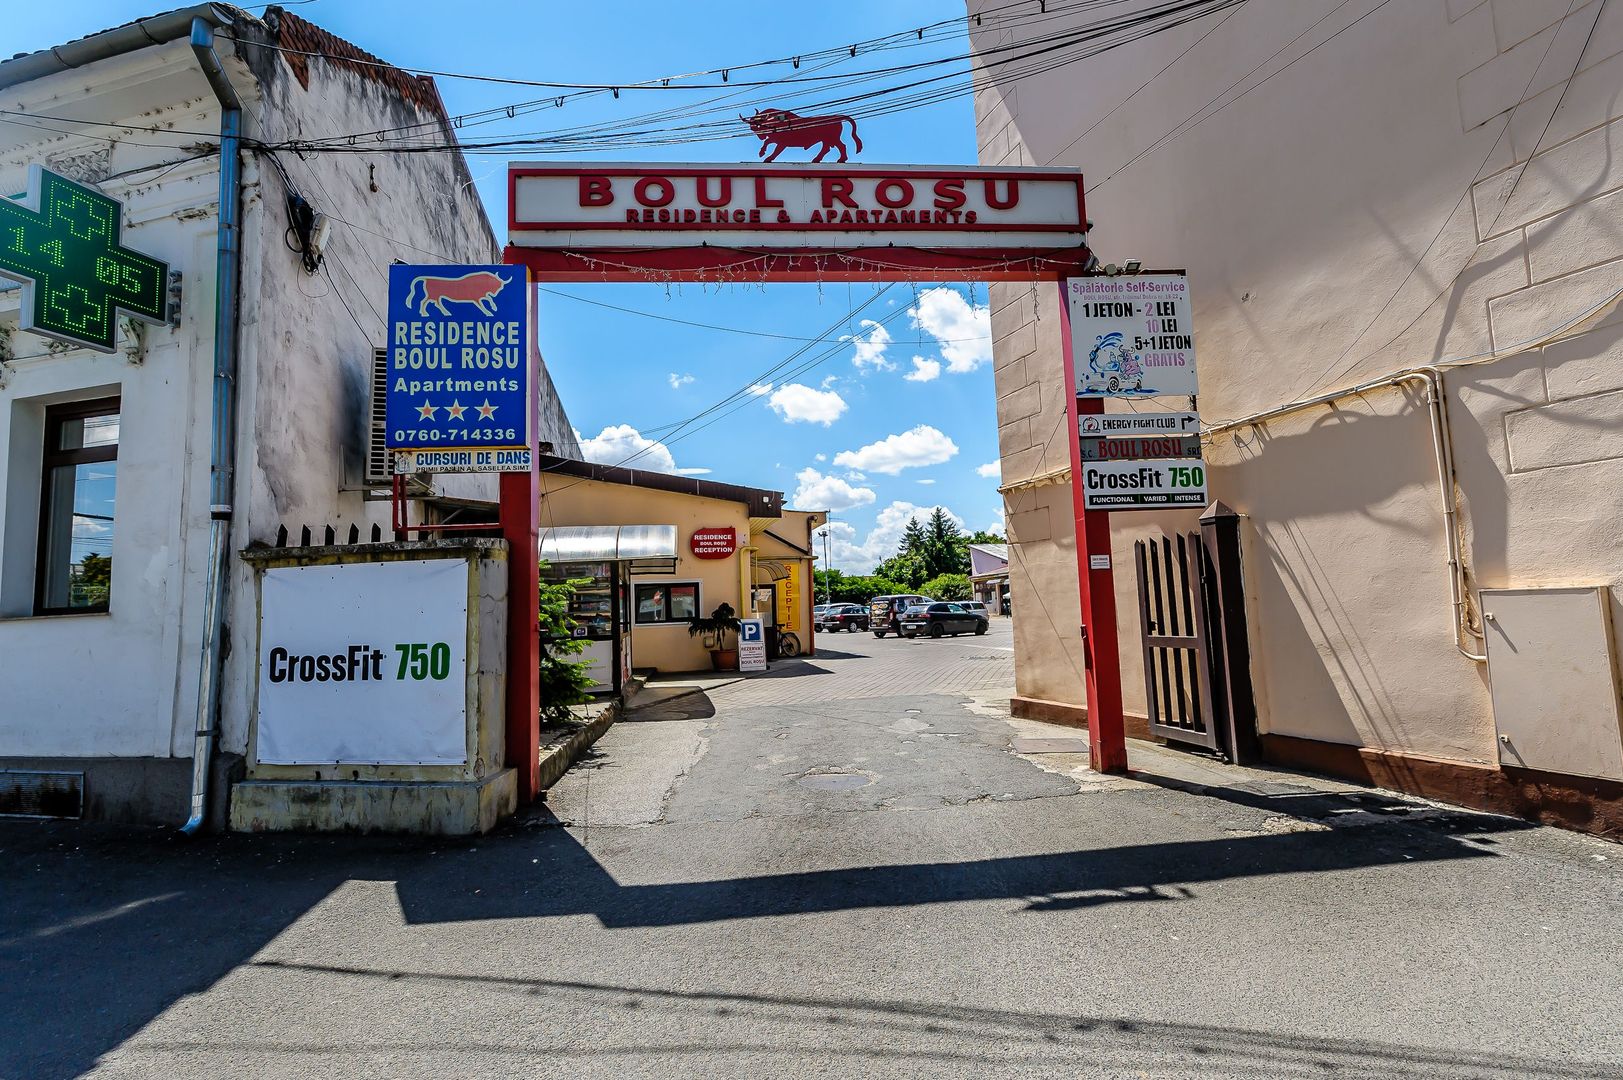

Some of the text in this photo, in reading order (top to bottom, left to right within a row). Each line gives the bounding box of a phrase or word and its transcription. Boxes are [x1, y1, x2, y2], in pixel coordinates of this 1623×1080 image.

[579, 176, 784, 207] BOUL
[626, 208, 977, 223] RESIDENCE & APARTAMENTS
[1126, 281, 1185, 293] Self-Service
[1082, 303, 1090, 317] 1
[1093, 302, 1133, 317] JETON
[1144, 302, 1153, 317] 2
[1156, 301, 1176, 317] LEI
[395, 321, 520, 345] RESIDENCE
[1145, 318, 1178, 334] 10 LEI
[1134, 335, 1192, 350] 5+1 JETON
[394, 347, 519, 370] BOUL ROSU
[1144, 352, 1186, 367] GRATIS
[394, 377, 519, 396] Apartments
[1102, 418, 1176, 430] ENERGY FIGHT CLUB
[394, 428, 516, 442] 0760-714336
[1097, 440, 1139, 458] BOUL
[1141, 439, 1183, 456] ROSU
[416, 452, 530, 466] CURSURI DE DANS
[1087, 466, 1204, 490] CrossFit 750
[745, 624, 757, 640] P
[269, 642, 451, 684] CrossFit 750
